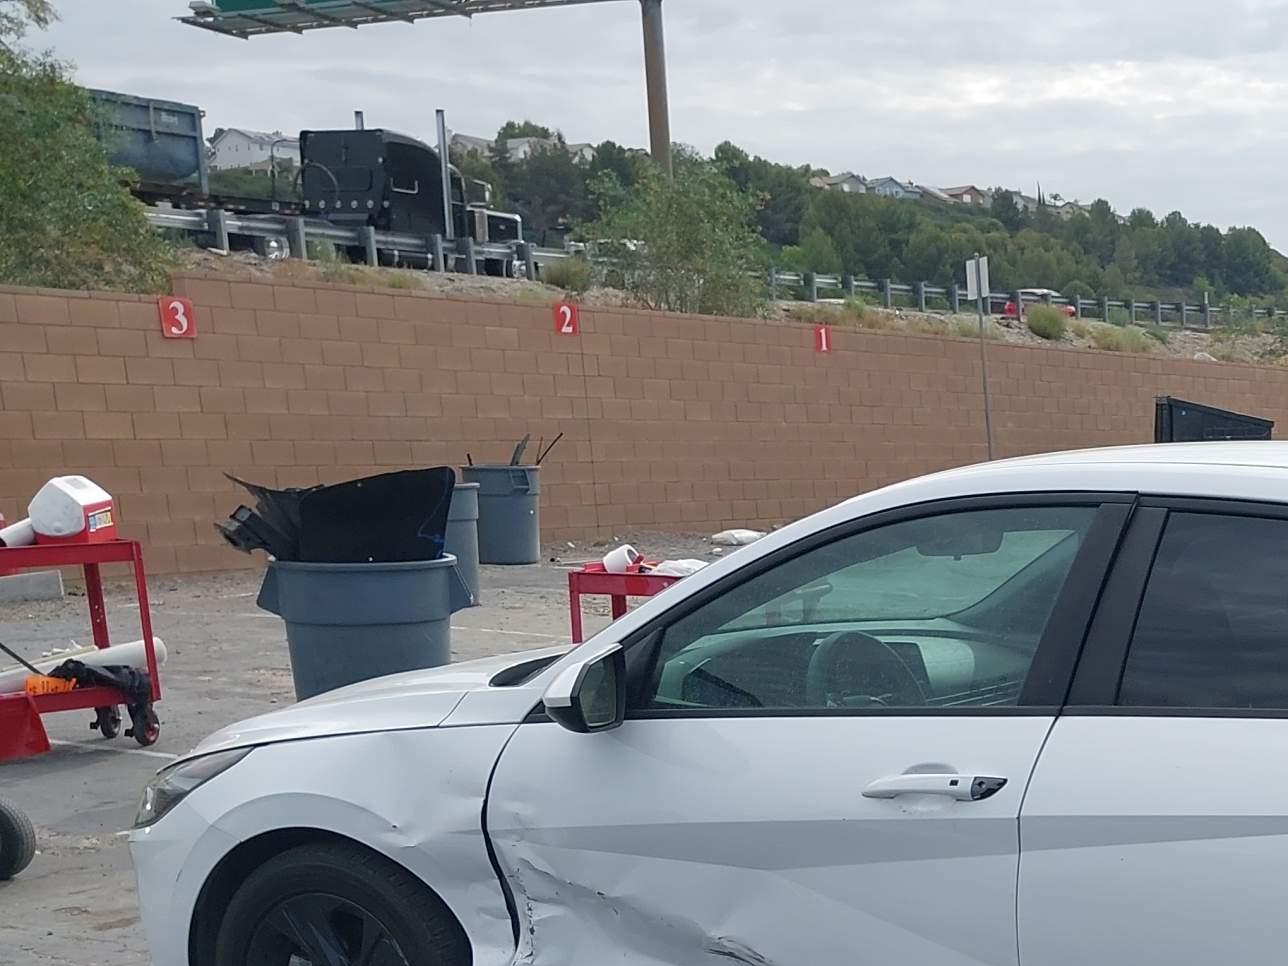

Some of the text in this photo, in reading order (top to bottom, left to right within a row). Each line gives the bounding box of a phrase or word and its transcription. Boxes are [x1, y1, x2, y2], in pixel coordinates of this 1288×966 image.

[169, 301, 188, 334] 3
[559, 305, 573, 333] 2
[819, 327, 828, 351] 1
